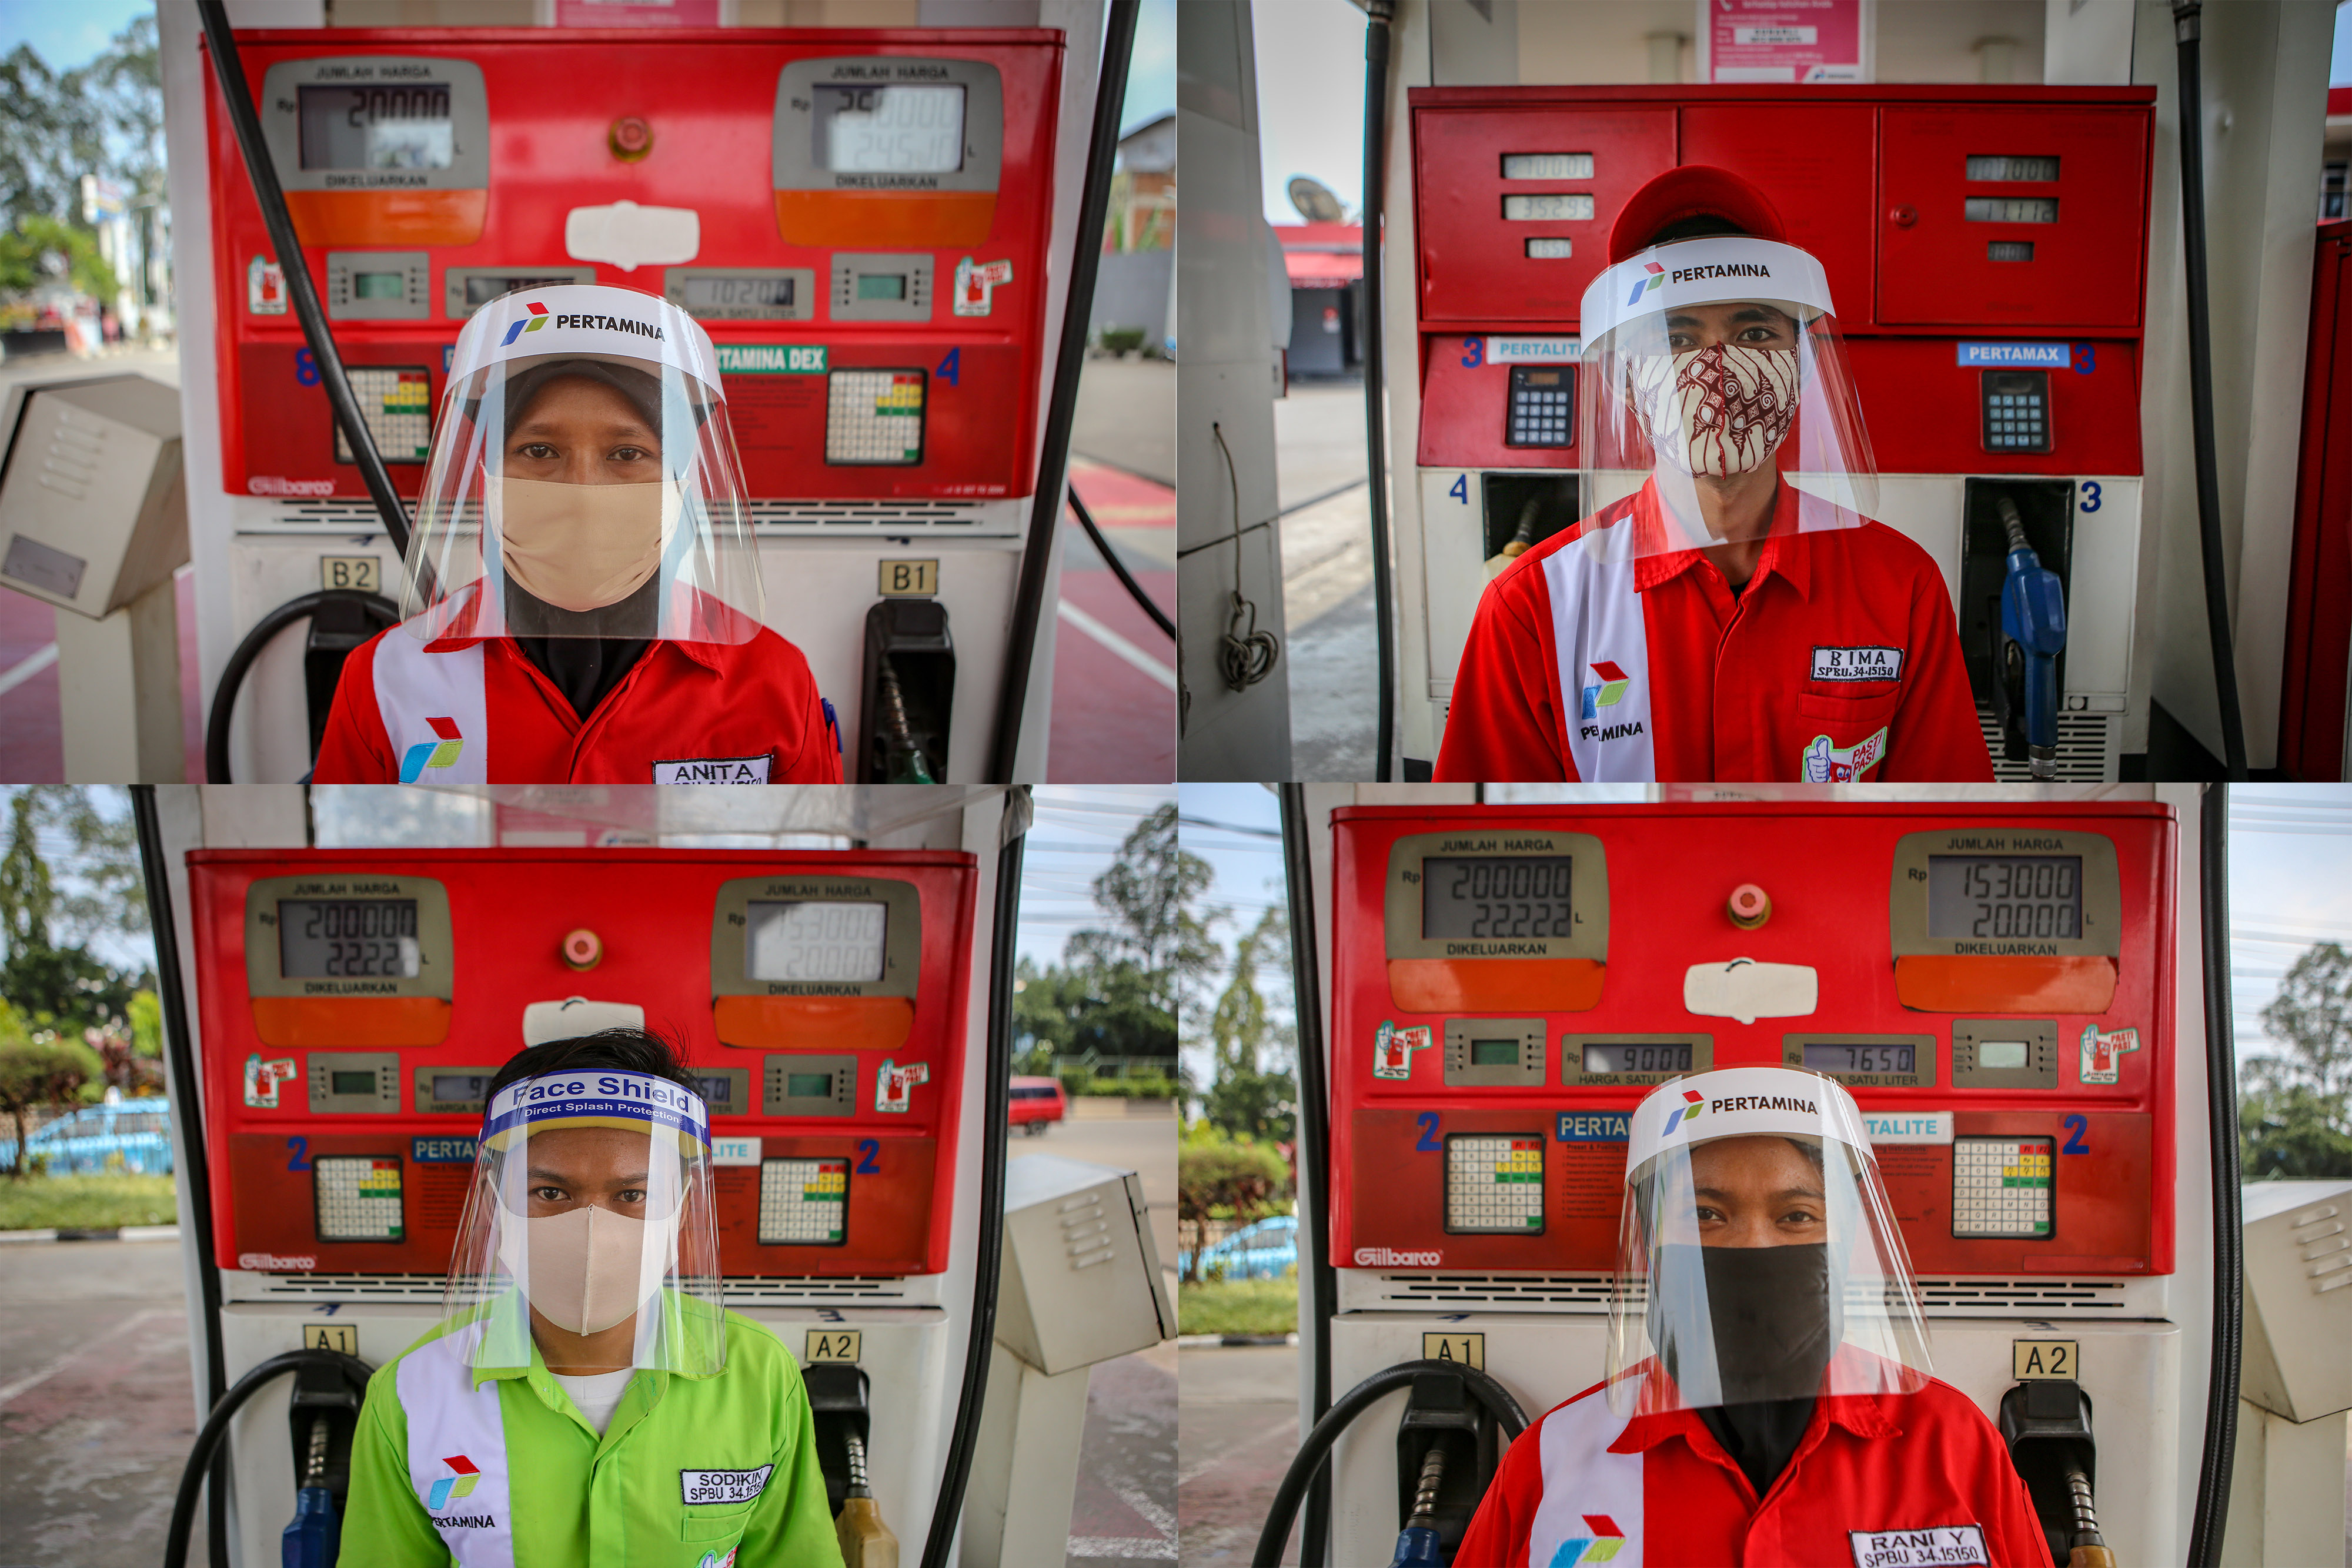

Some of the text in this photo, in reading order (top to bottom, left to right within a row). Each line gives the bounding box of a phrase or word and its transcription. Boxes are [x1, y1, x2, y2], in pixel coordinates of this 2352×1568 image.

[315, 66, 432, 80] JUMLAH HARGA
[831, 65, 950, 81] JUMLAH HARGA
[967, 145, 976, 158] L
[325, 175, 428, 188] DIKELUARKAN
[836, 175, 938, 190] DIKELUARKAN
[1672, 263, 1771, 284] PERTAMINA
[556, 314, 666, 343] PERTAMINA
[789, 348, 824, 370] DEX
[1461, 337, 1484, 369] 3
[1969, 347, 2059, 362] PERTAMAX
[2074, 343, 2096, 375] 3
[936, 346, 961, 386] 4
[1449, 474, 1468, 504] 4
[2080, 481, 2102, 513] 3
[332, 561, 370, 588] B2
[893, 564, 925, 590] B1
[1580, 721, 1644, 742] PEMINA
[1852, 731, 1883, 764] PASTI
[675, 764, 754, 782] ANITA
[1440, 840, 1554, 852] JUMLAH HARGA
[1947, 838, 2063, 851] JUMLAH HARGA
[1402, 871, 1421, 885] Rp
[1452, 865, 1571, 900] 200000
[1908, 868, 1927, 882] Rp
[1965, 864, 2074, 900] 153000
[293, 883, 400, 895] JUMLAH HARGA
[764, 885, 872, 898] JUMLAH HARGA
[727, 912, 746, 928] Rp
[1575, 913, 1583, 924] L
[2086, 914, 2094, 925] L
[1446, 944, 1548, 956] DIKELUARKAN
[1955, 943, 2057, 957] DIKELUARKAN
[888, 957, 896, 969] L
[305, 982, 397, 994] DIKELUARKAN
[768, 984, 862, 997] DIKELUARKAN
[1567, 1053, 1581, 1064] Rp
[1623, 1048, 1691, 1071] 9000
[1789, 1052, 1802, 1065] Rp
[1845, 1048, 1911, 1072] 7650
[1579, 1074, 1621, 1085] HARGA
[1626, 1075, 1656, 1085] SATU
[1848, 1075, 1919, 1086] SATU LITER
[513, 1081, 585, 1105] Face
[597, 1077, 690, 1113] Shield
[524, 1102, 680, 1124] Direct Splash Protection
[1712, 1095, 1819, 1115] PERTAMINA
[1416, 1112, 1442, 1152] 2
[1561, 1117, 1629, 1136] PERTA
[1866, 1119, 1937, 1135] TALITE
[2062, 1114, 2089, 1155] 2
[287, 1136, 311, 1172] 2
[415, 1141, 477, 1158] PERTA
[857, 1139, 881, 1175] 2
[238, 1253, 316, 1270] Gilbarco
[1354, 1248, 1441, 1266] Gilbarco
[317, 1329, 346, 1351] A1
[816, 1335, 851, 1359] A2
[1439, 1338, 1471, 1365] A1
[2025, 1346, 2067, 1374] A2
[699, 1469, 763, 1486] SODIKIN
[690, 1487, 724, 1500] SPBU
[1870, 1531, 1965, 1550] RANI Y
[1864, 1549, 1910, 1568] SPBU
